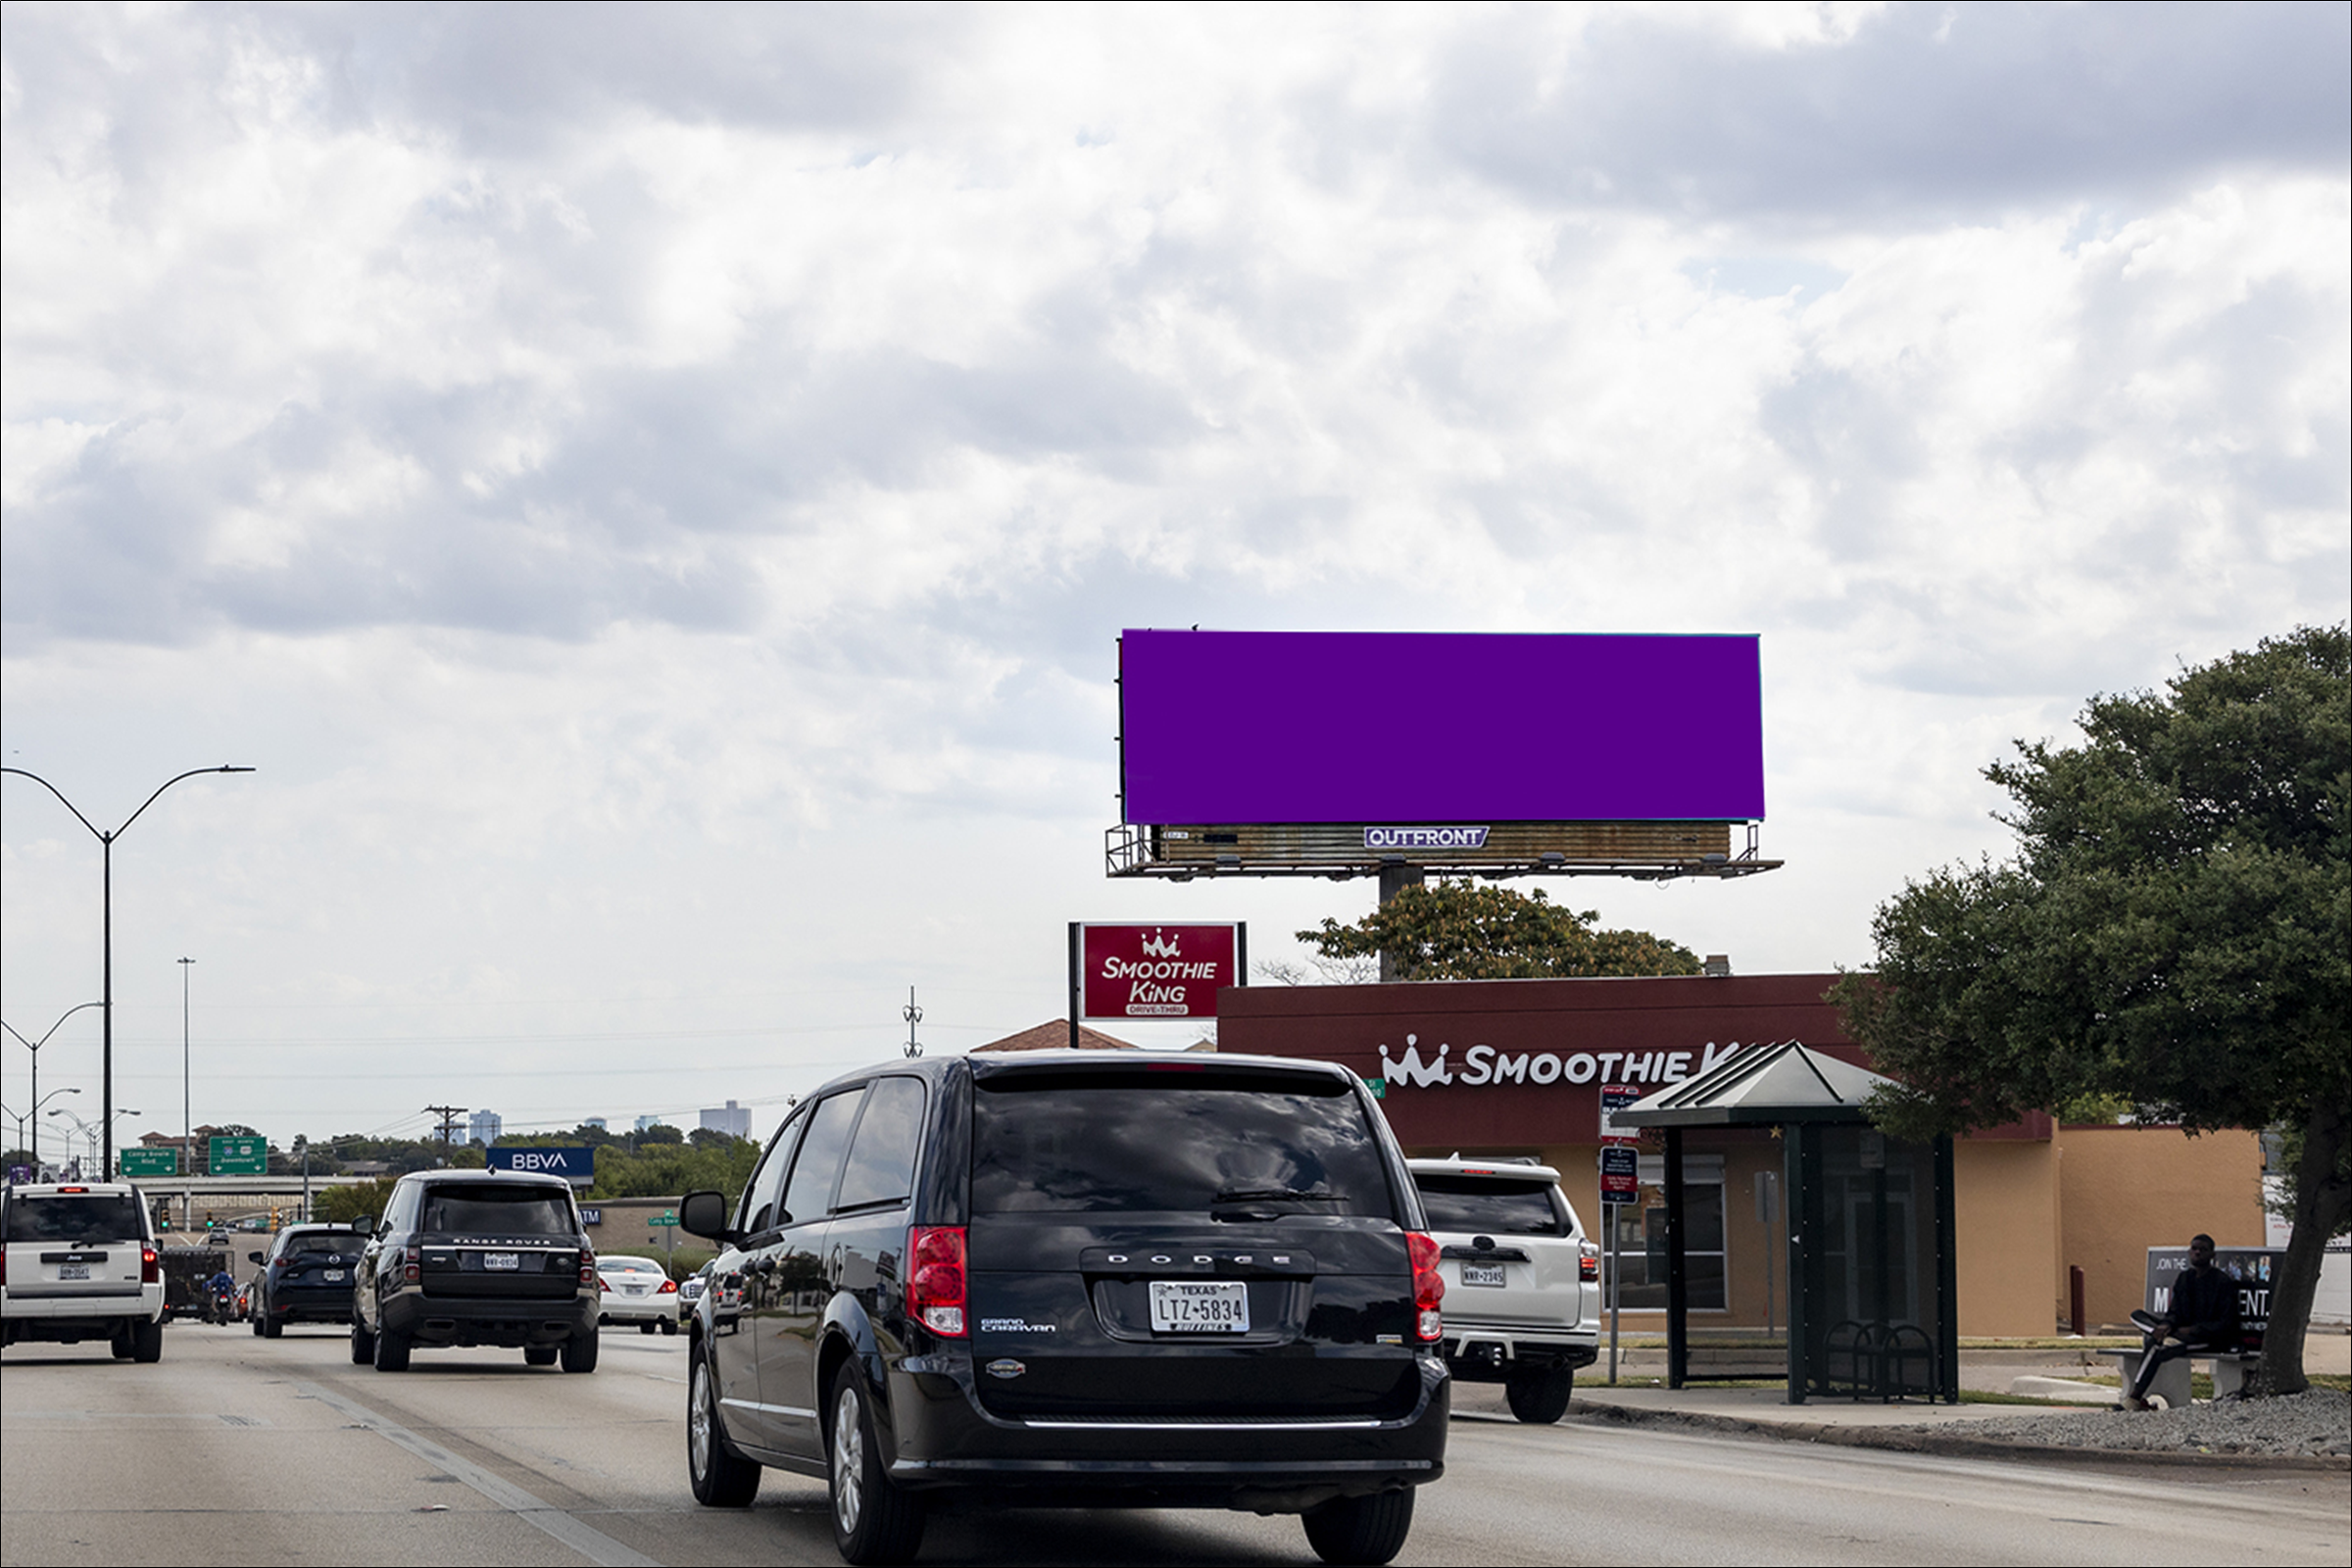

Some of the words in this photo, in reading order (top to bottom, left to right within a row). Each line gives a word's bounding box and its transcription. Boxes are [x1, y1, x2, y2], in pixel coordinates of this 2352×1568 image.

[1369, 829, 1482, 847] OUTFRONT
[1102, 956, 1218, 980] SMOOTHIE
[1129, 1005, 1186, 1015] DRIVE-THRU
[1460, 1045, 1692, 1085] SMOOTHIE
[512, 1152, 567, 1170] BBVA
[1108, 1254, 1291, 1265] DODGE
[1181, 1286, 1216, 1296] TEXAS
[981, 1324, 1056, 1333] CARAVAN
